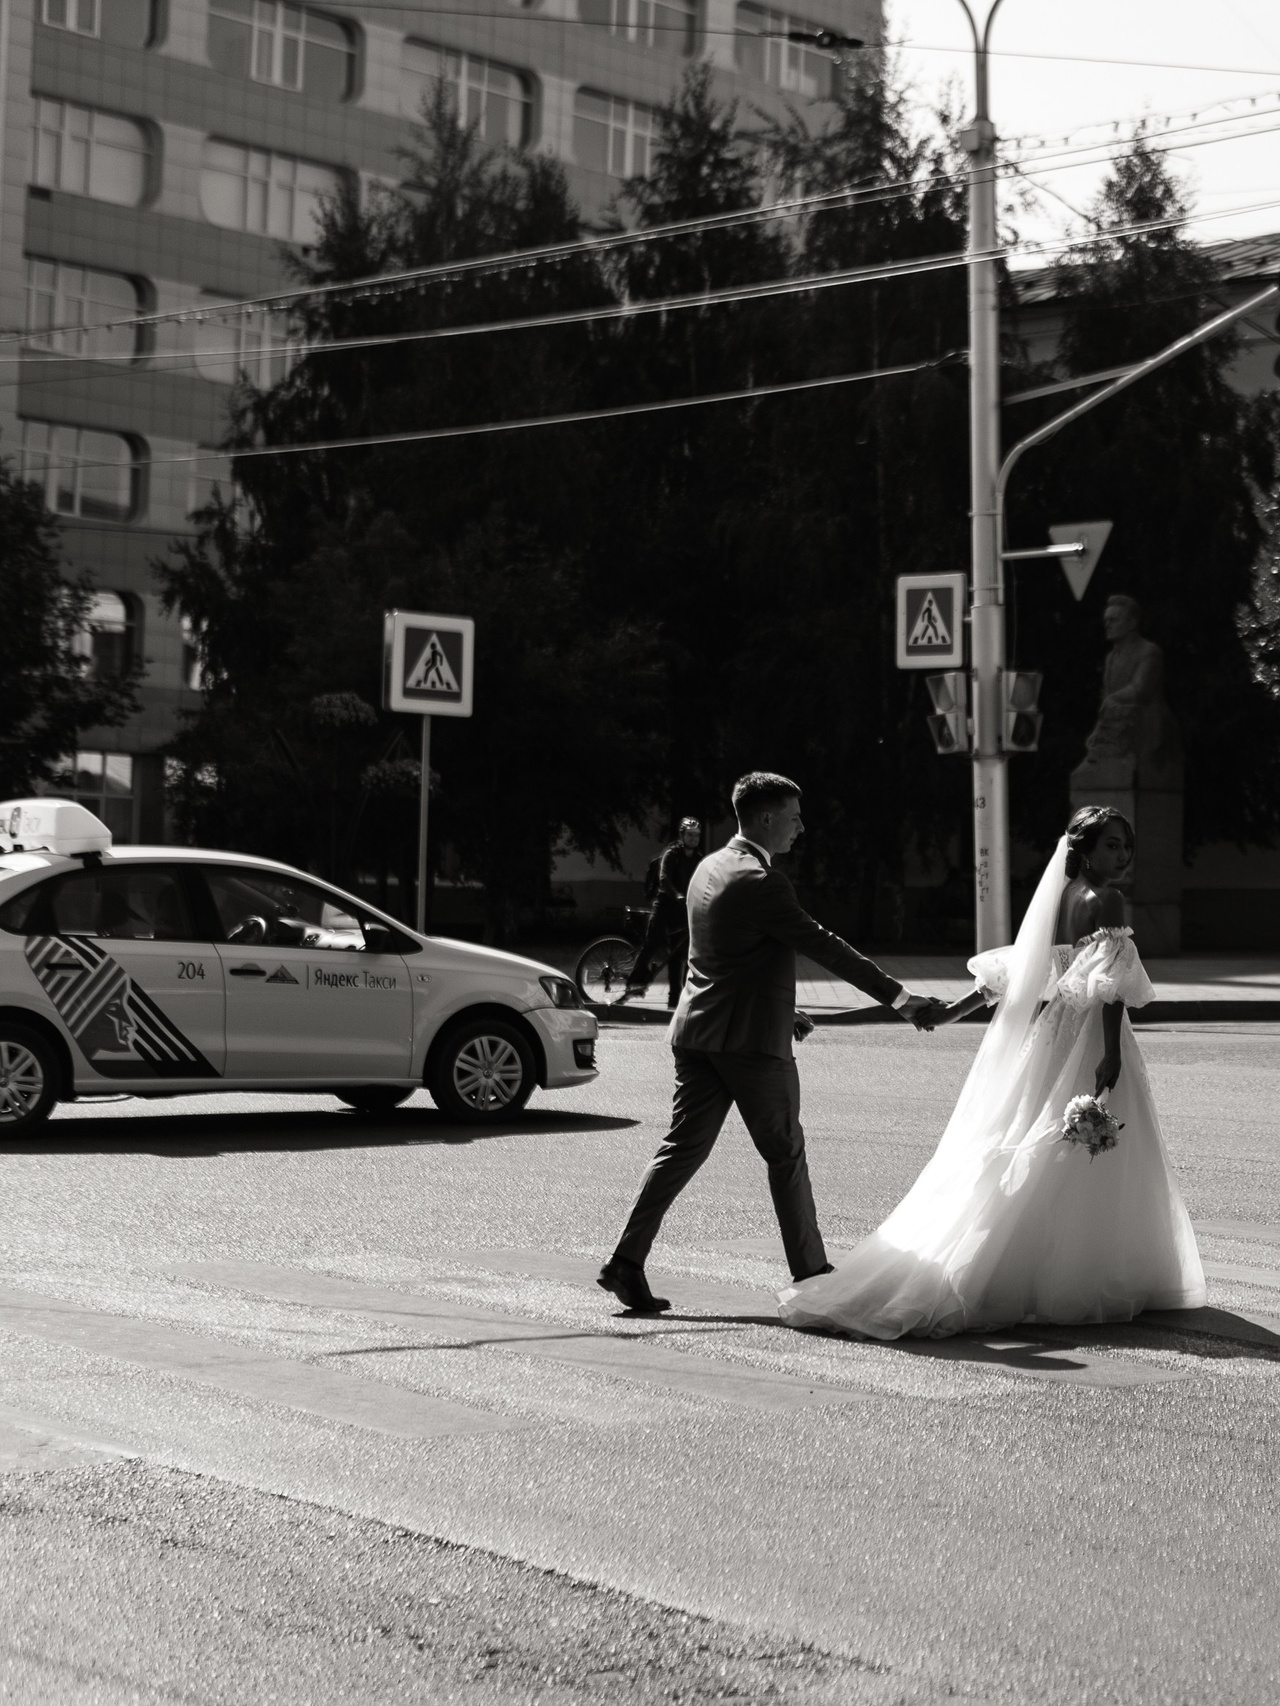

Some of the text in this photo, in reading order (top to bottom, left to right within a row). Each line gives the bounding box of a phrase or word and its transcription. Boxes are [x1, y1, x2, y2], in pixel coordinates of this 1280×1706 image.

[177, 961, 206, 980] 204
[314, 968, 397, 990] Яндекс Такси
